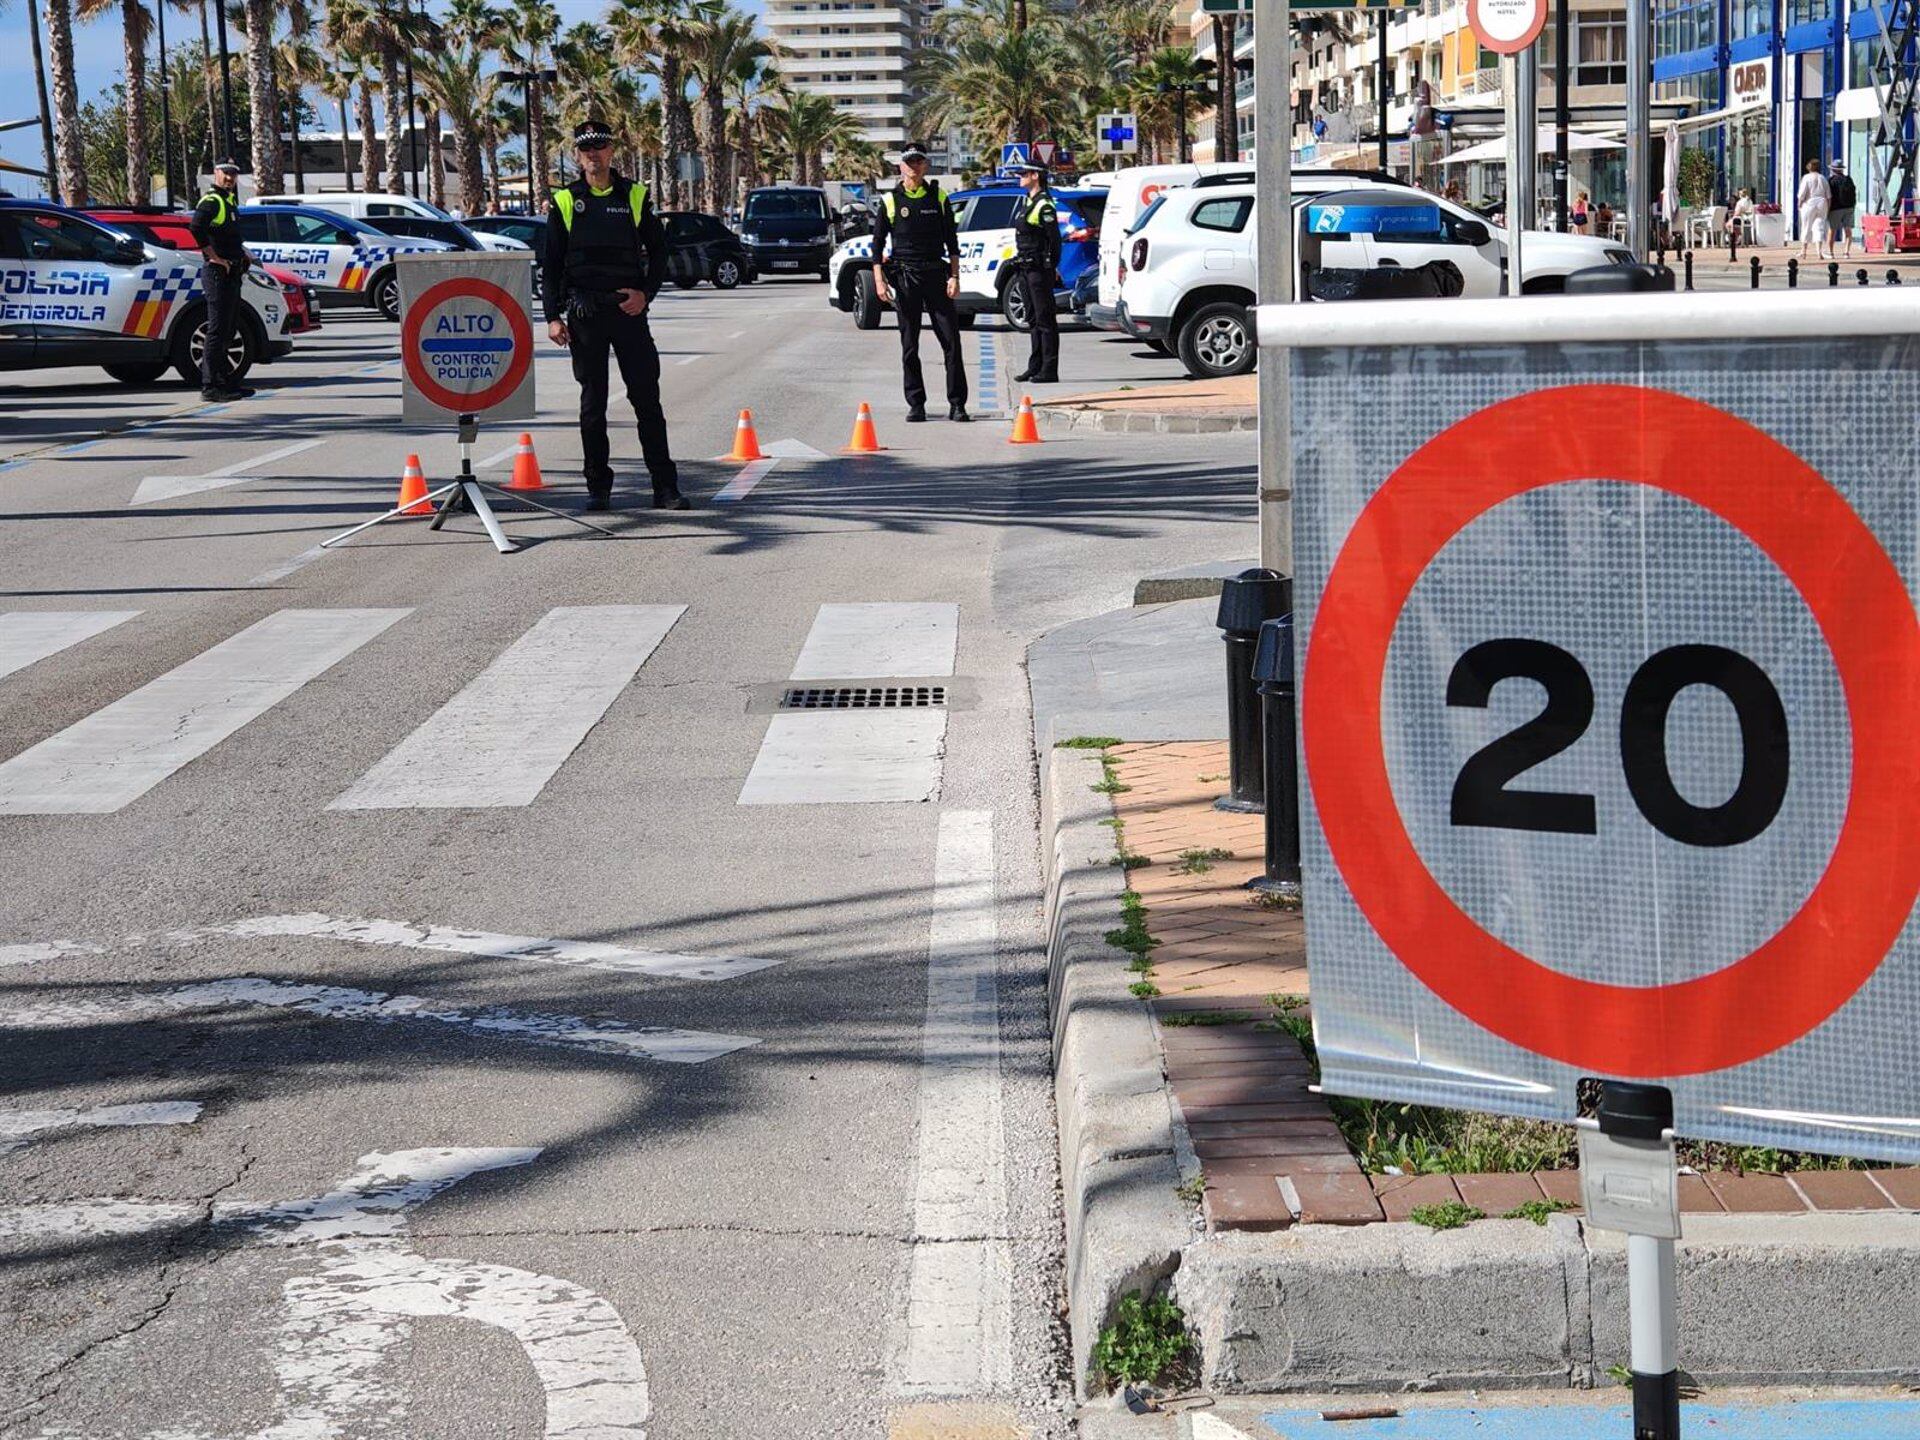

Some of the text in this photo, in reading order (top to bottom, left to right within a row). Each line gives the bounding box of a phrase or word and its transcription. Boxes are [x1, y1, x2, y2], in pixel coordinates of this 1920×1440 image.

[0, 269, 110, 295] OLICIA
[436, 315, 494, 334] ALTO
[432, 353, 499, 366] CONTROL
[438, 366, 493, 379] POLICIA
[1446, 637, 1791, 848] 20
